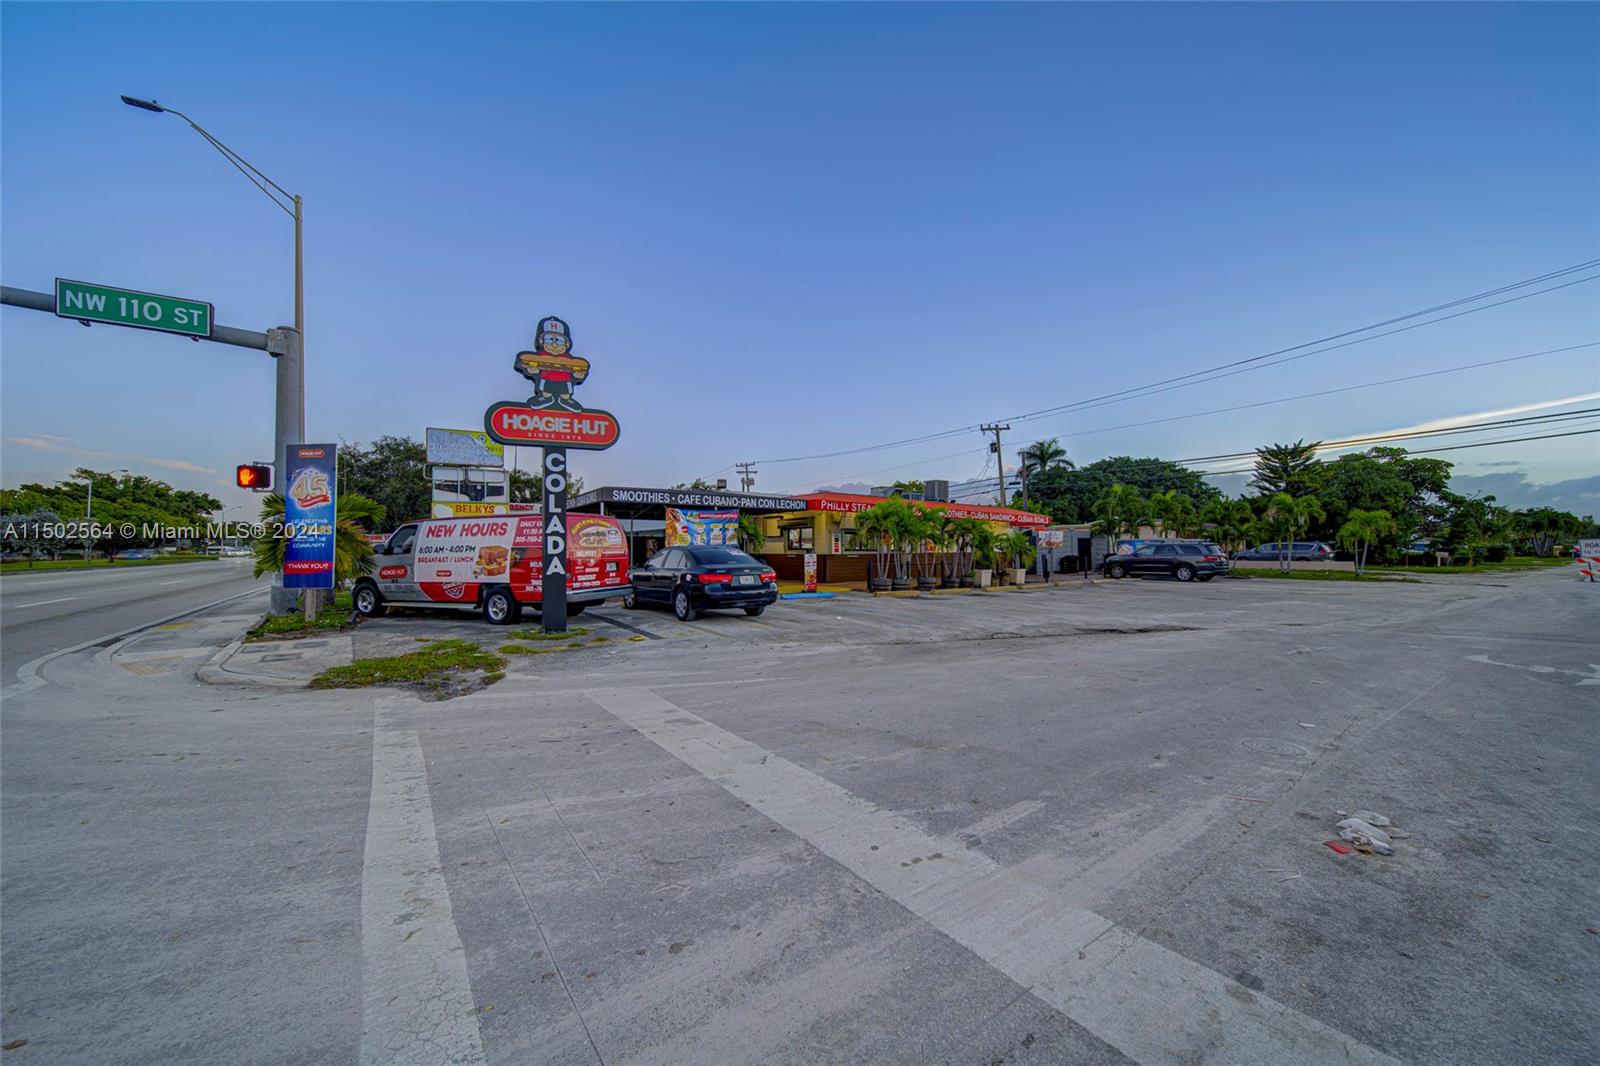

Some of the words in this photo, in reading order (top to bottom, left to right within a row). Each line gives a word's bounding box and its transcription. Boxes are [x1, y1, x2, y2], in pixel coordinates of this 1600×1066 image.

[65, 289, 106, 312] NW
[119, 297, 162, 322] 110
[173, 307, 203, 326] ST
[502, 413, 571, 433] HOAGIE
[573, 418, 609, 436] HUT
[612, 489, 670, 504] SMOOTHIES
[677, 494, 701, 505] CAFE
[758, 498, 775, 509] CON
[776, 499, 807, 510] LECHON
[821, 501, 849, 511] PHILLY
[851, 502, 872, 512] STEA
[545, 452, 566, 575] COLADA
[426, 524, 457, 538] NEW
[460, 522, 509, 537] HOURS
[419, 546, 433, 554] 6:00
[449, 545, 464, 553] 4:00
[465, 545, 476, 553] PM
